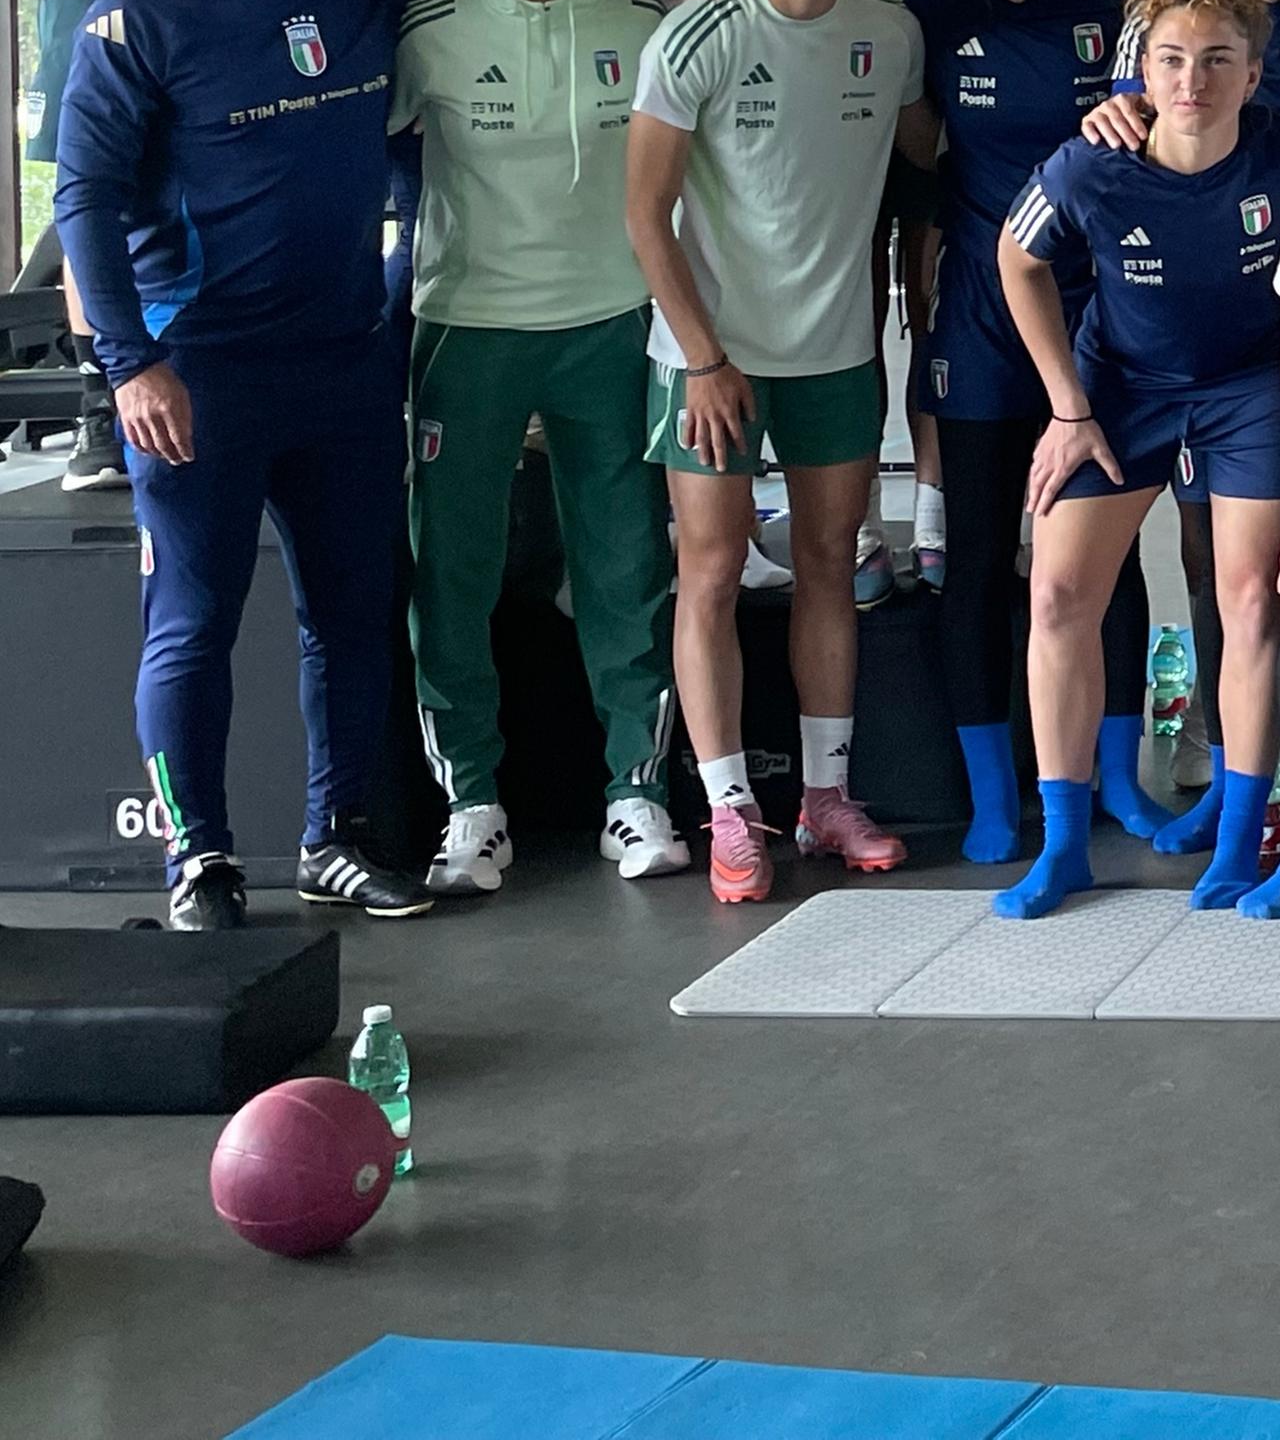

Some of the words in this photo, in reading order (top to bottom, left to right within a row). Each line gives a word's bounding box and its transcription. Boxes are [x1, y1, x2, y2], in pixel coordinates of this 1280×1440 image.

[971, 77, 996, 89] TIM
[959, 91, 996, 105] Poste
[247, 105, 275, 121] TIM
[279, 95, 316, 113] Poste
[487, 102, 515, 113] TIM
[753, 101, 776, 112] TIM
[471, 119, 515, 130] Poste
[735, 117, 775, 129] Poste
[1137, 259, 1163, 271] TIM
